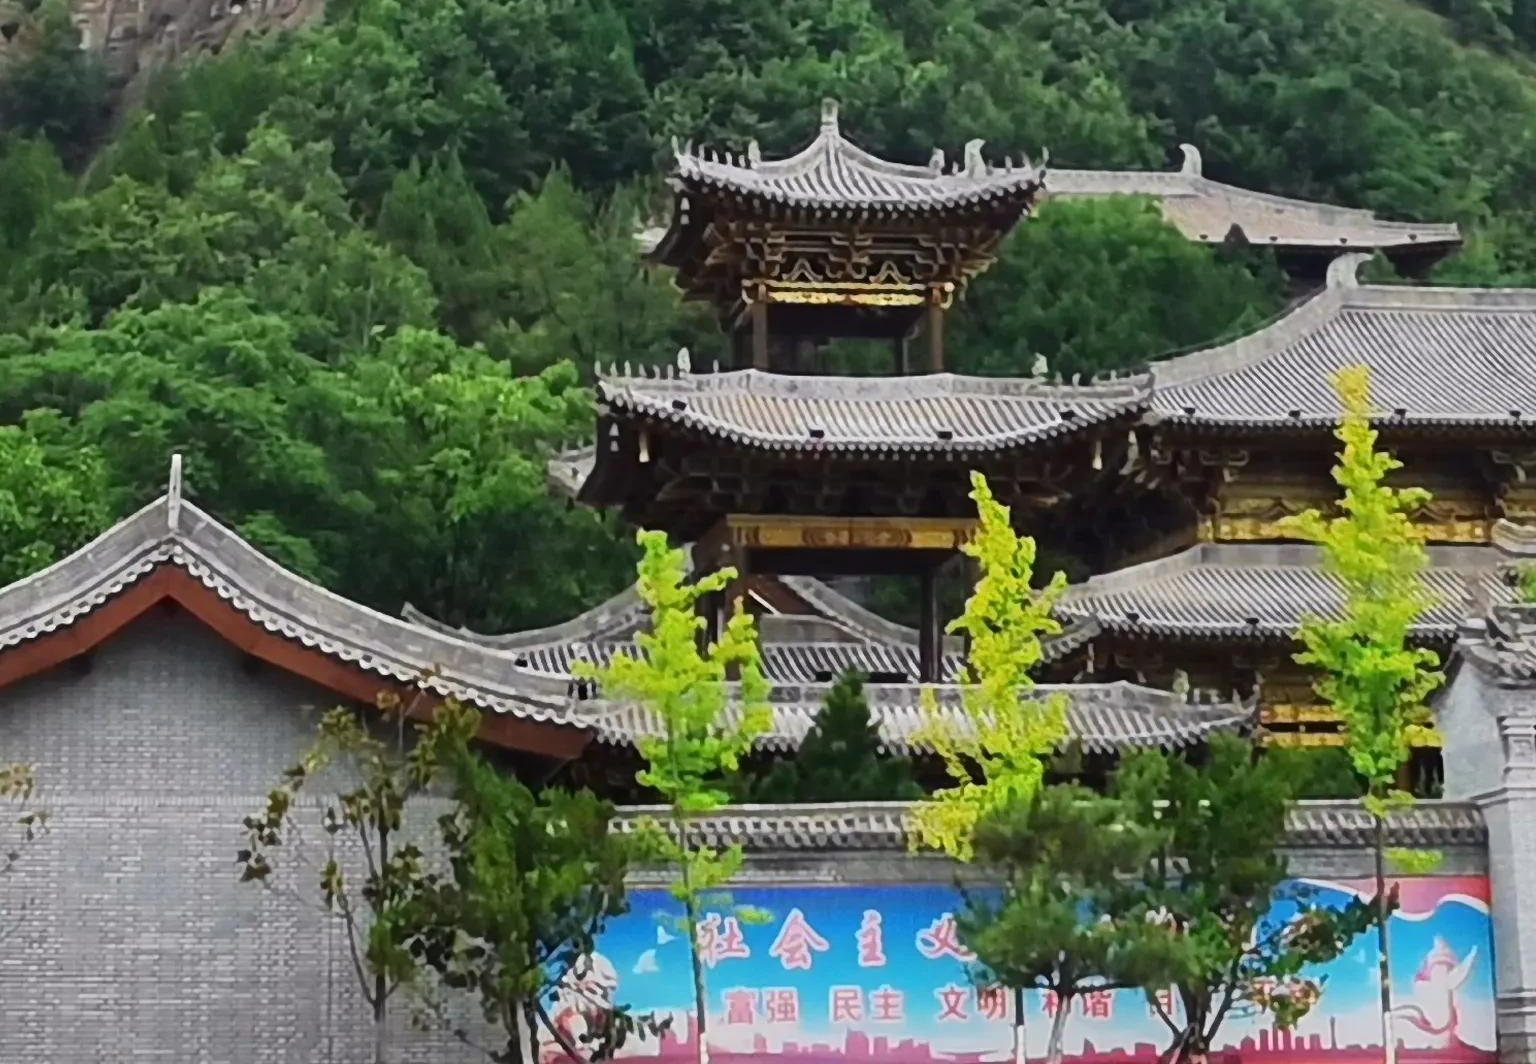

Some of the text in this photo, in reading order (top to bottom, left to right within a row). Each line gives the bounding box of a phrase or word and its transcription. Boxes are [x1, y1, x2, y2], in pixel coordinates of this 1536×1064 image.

[724, 987, 798, 1025] 富强
[830, 986, 904, 1022] 民主
[935, 985, 1009, 1022] 文明
